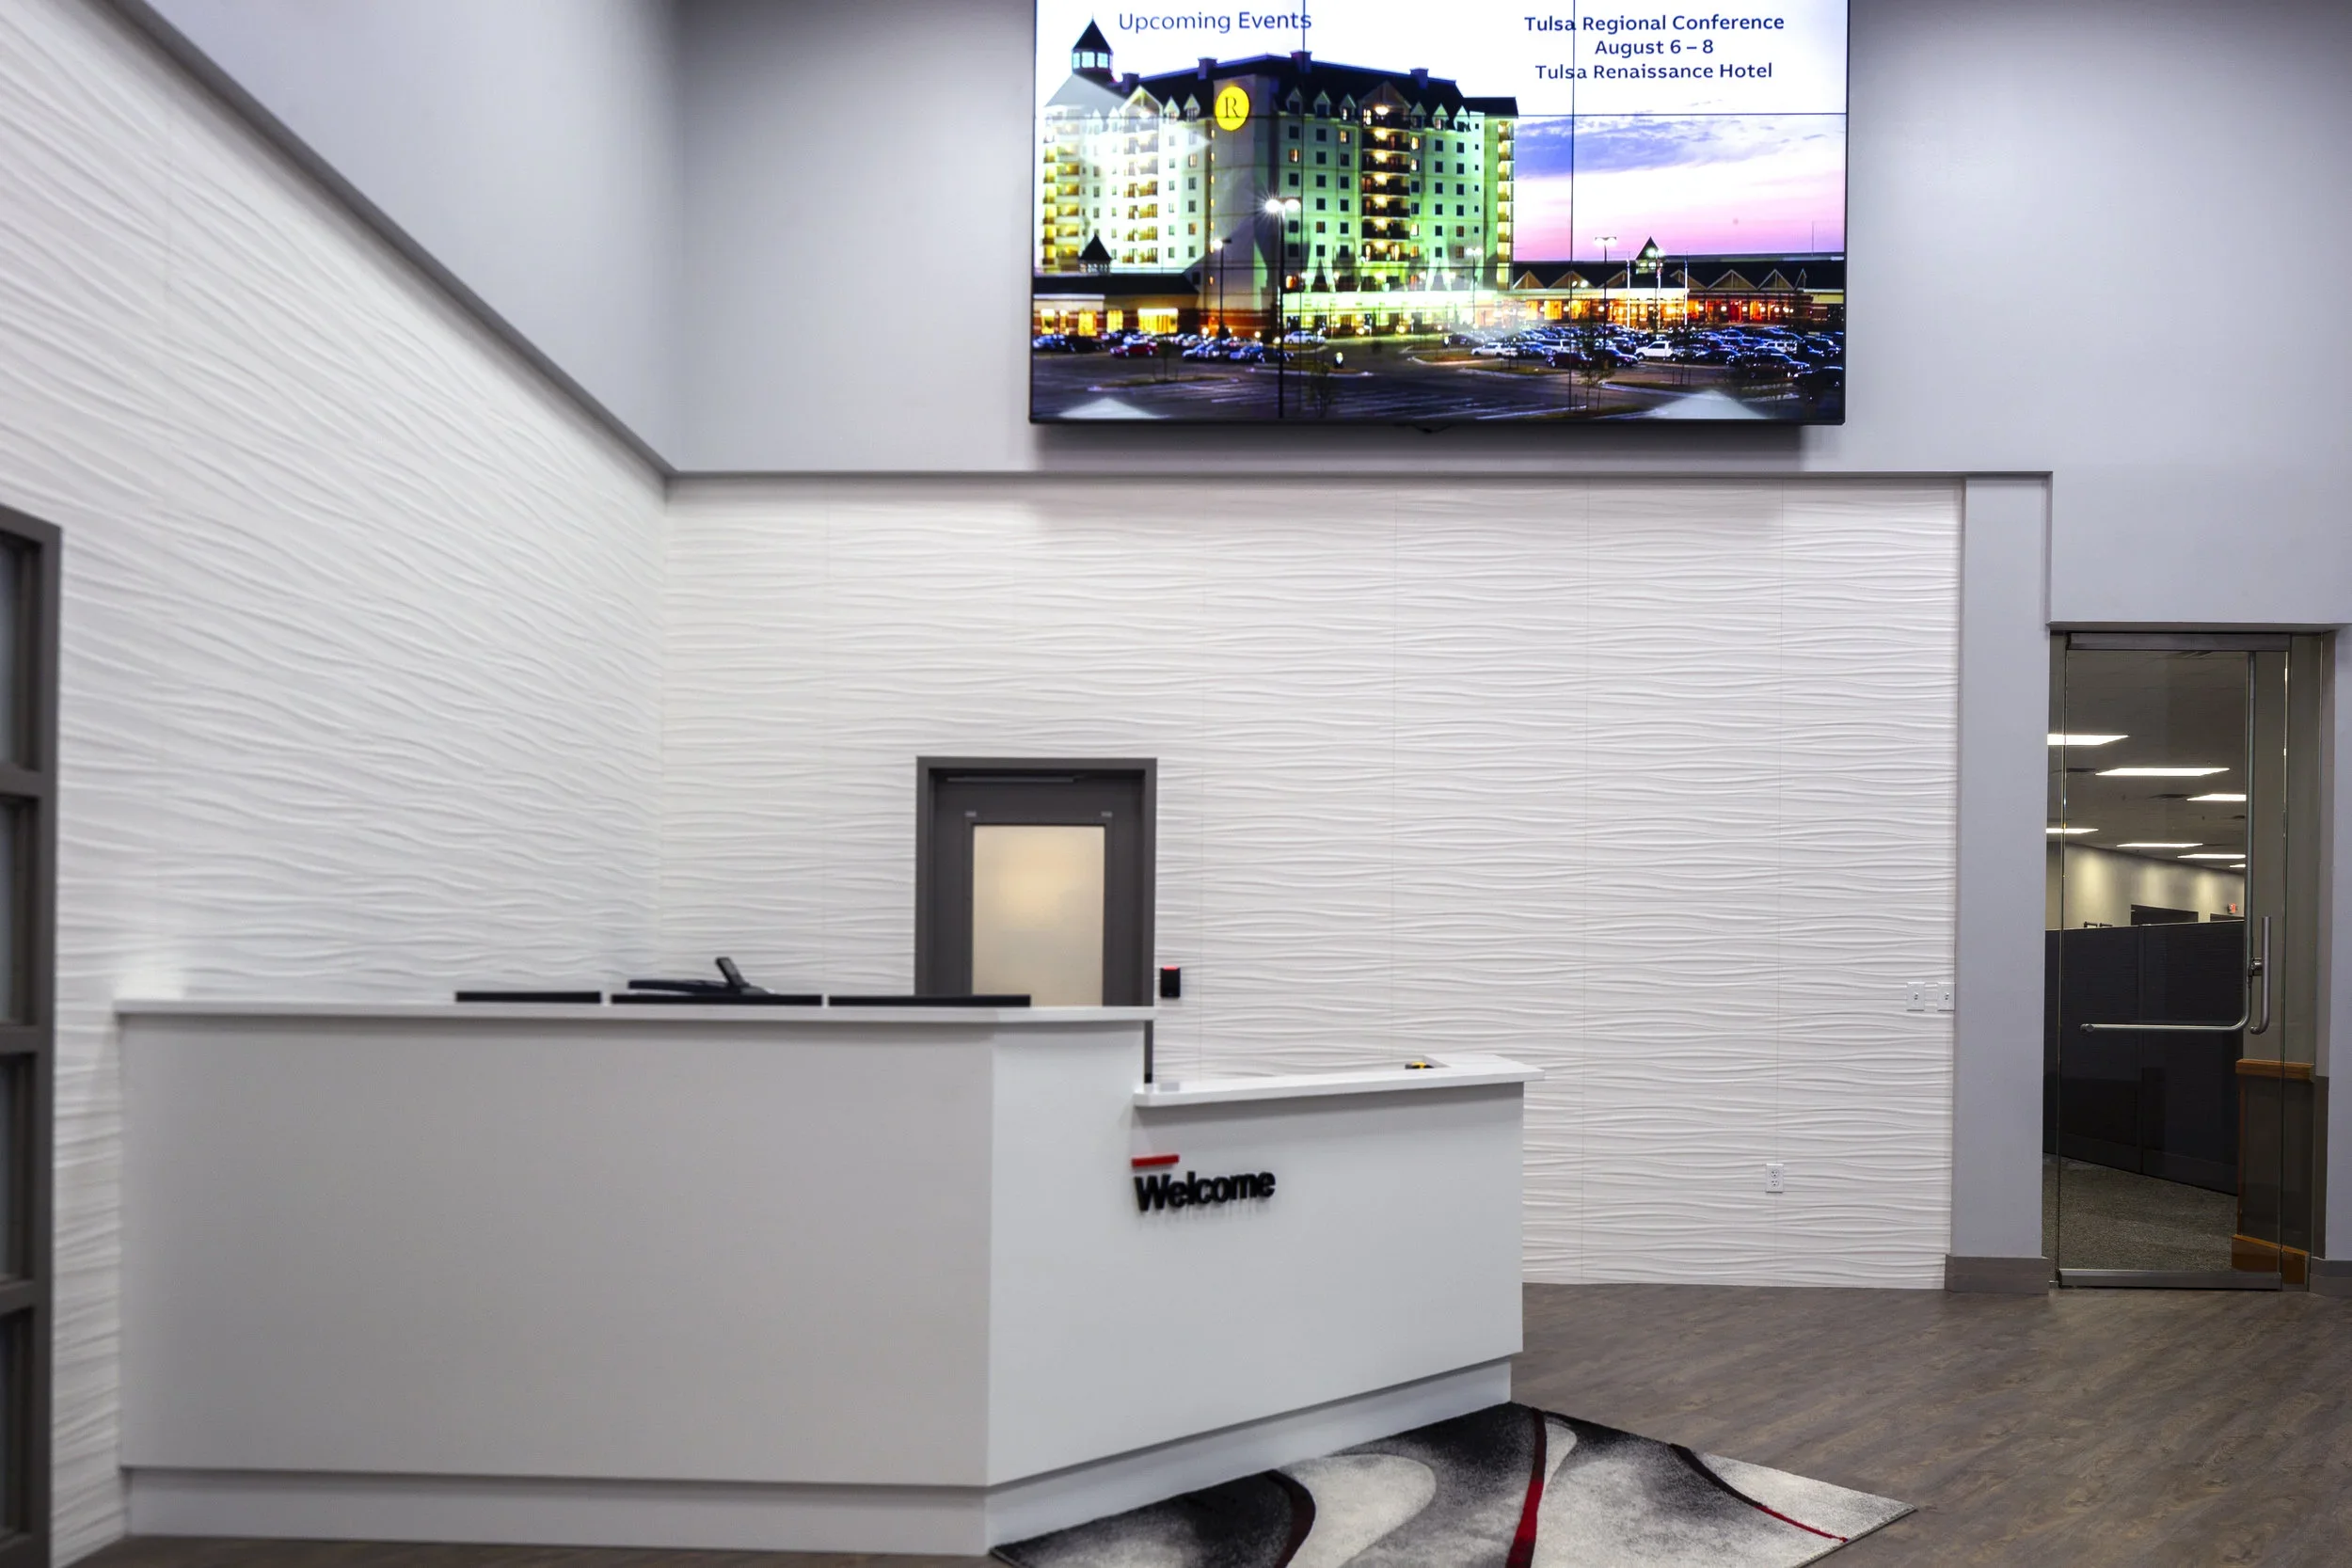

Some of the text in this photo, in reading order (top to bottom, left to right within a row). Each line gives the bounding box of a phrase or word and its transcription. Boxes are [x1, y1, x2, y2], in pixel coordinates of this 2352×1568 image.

[1119, 11, 1312, 34] Upcoming Events
[1524, 14, 1785, 35] Tulsa Regional Conference
[1595, 40, 1664, 58] August
[1670, 40, 1681, 54] 6
[1702, 40, 1714, 54] 8
[1535, 62, 1772, 79] Tulsa Renaissance Hotel
[1224, 96, 1240, 119] R
[1134, 1171, 1276, 1212] Welcome
